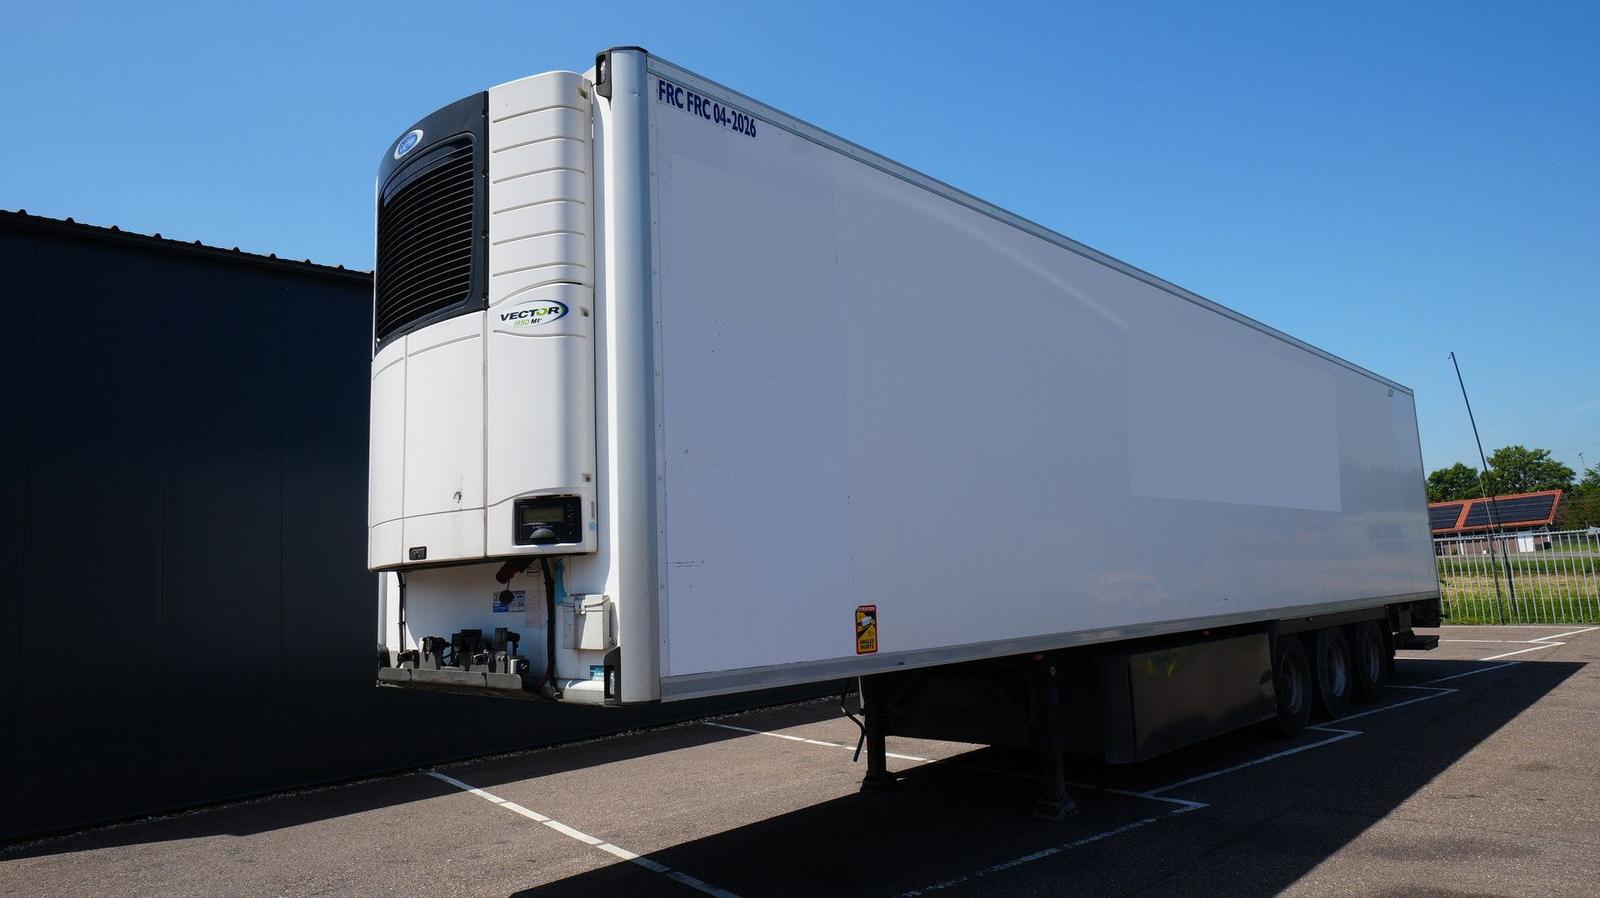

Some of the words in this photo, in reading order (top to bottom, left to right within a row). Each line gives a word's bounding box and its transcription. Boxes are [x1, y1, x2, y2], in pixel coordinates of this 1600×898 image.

[658, 80, 684, 109] FRC
[687, 91, 711, 120] FRC
[713, 103, 757, 138] 04-2026
[500, 306, 560, 322] VECTOR
